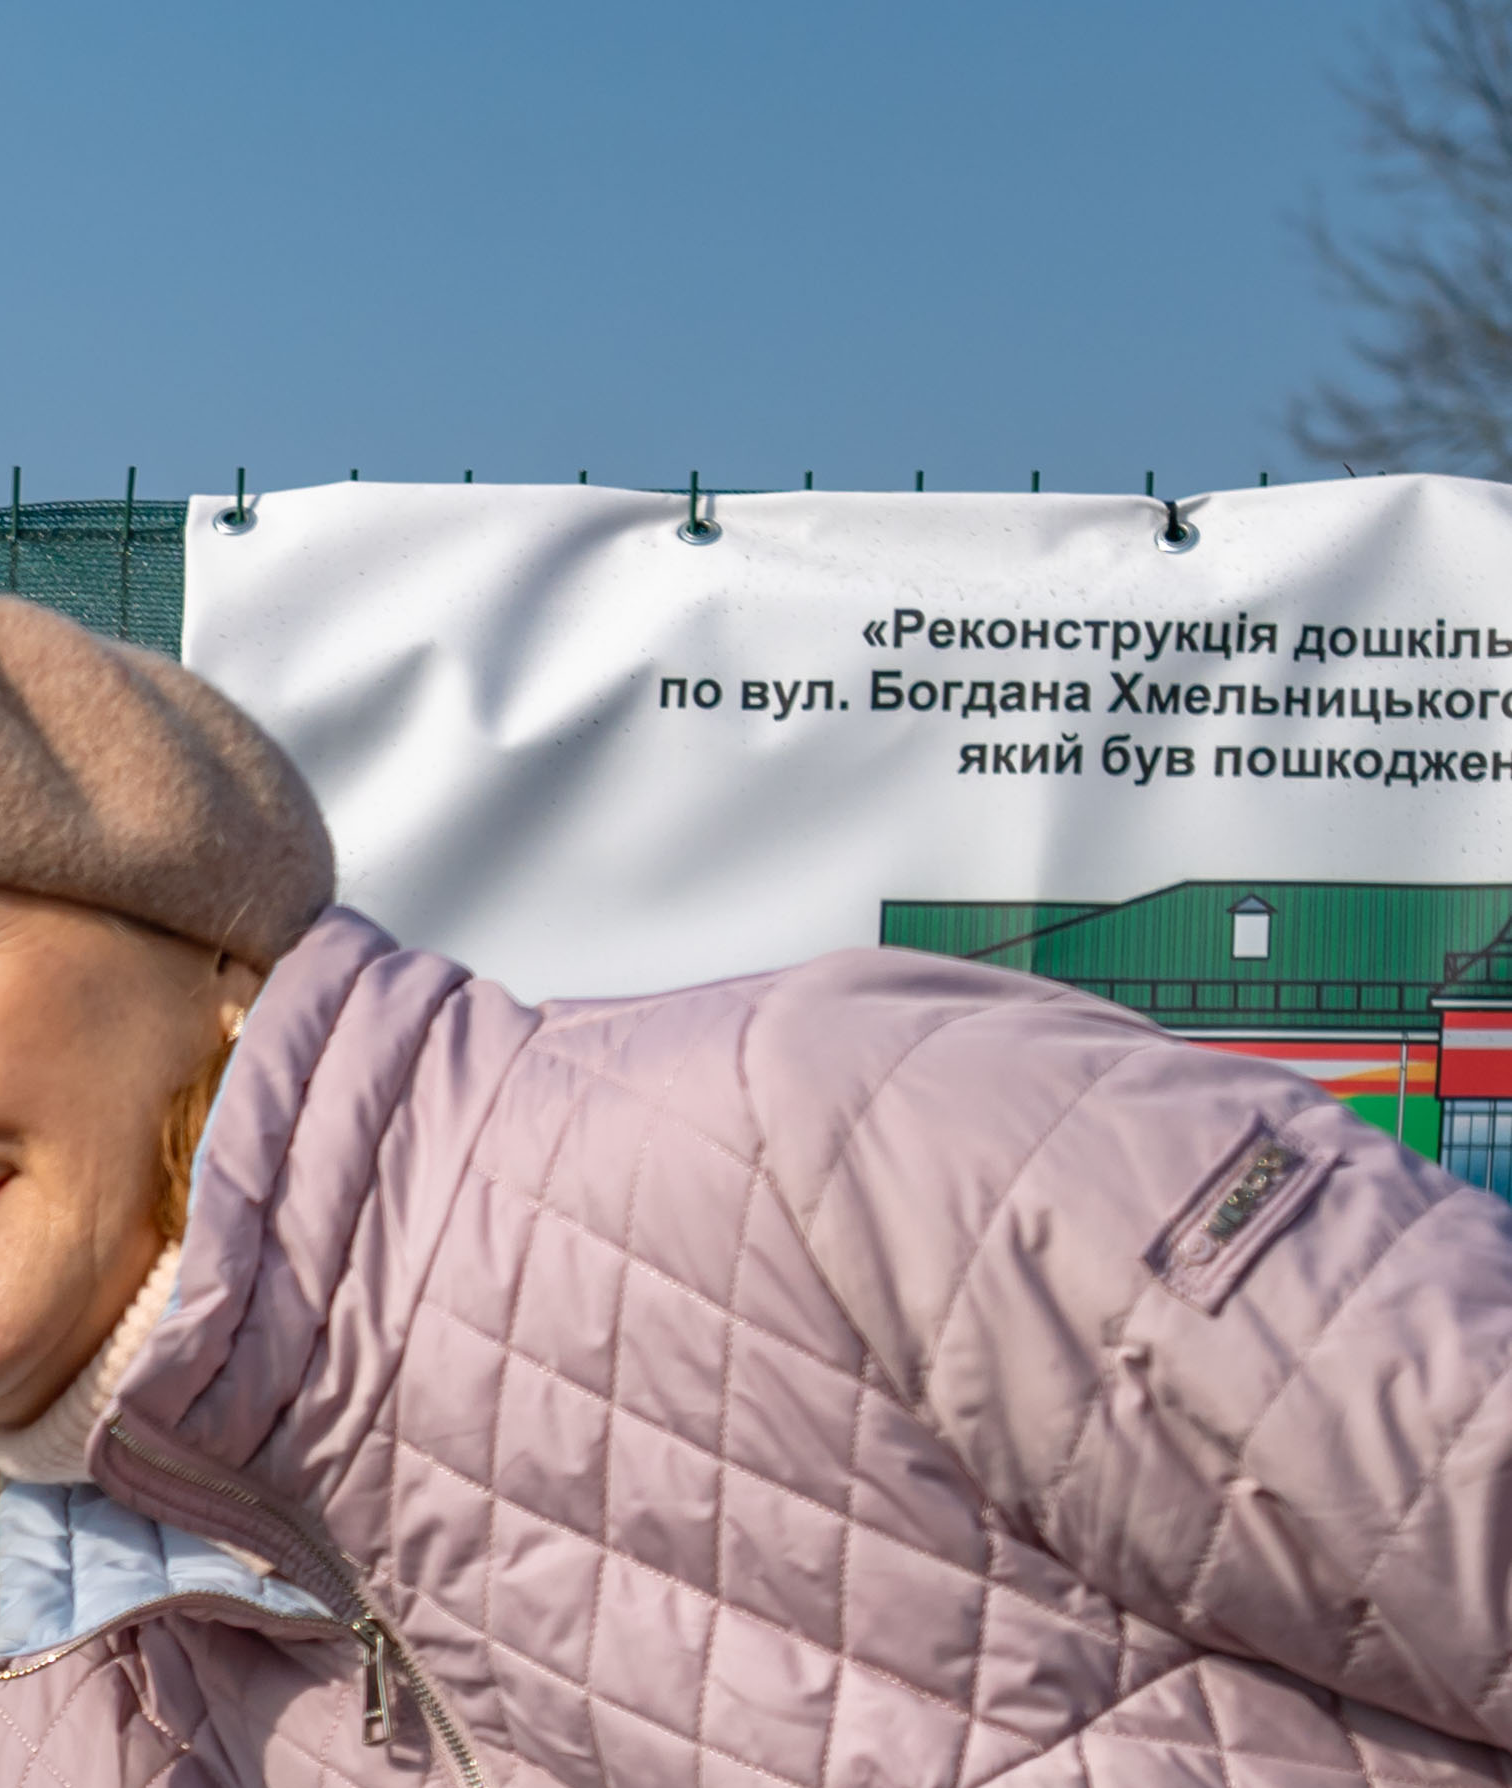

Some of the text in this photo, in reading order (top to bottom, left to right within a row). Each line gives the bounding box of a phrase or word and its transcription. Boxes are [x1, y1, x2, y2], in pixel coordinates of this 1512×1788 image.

[863, 608, 1278, 664] «Реконструкція
[660, 678, 723, 711] по
[741, 681, 850, 721] вул.
[869, 670, 1092, 720] Богдана
[959, 733, 1084, 775] який
[1101, 734, 1196, 787] був
